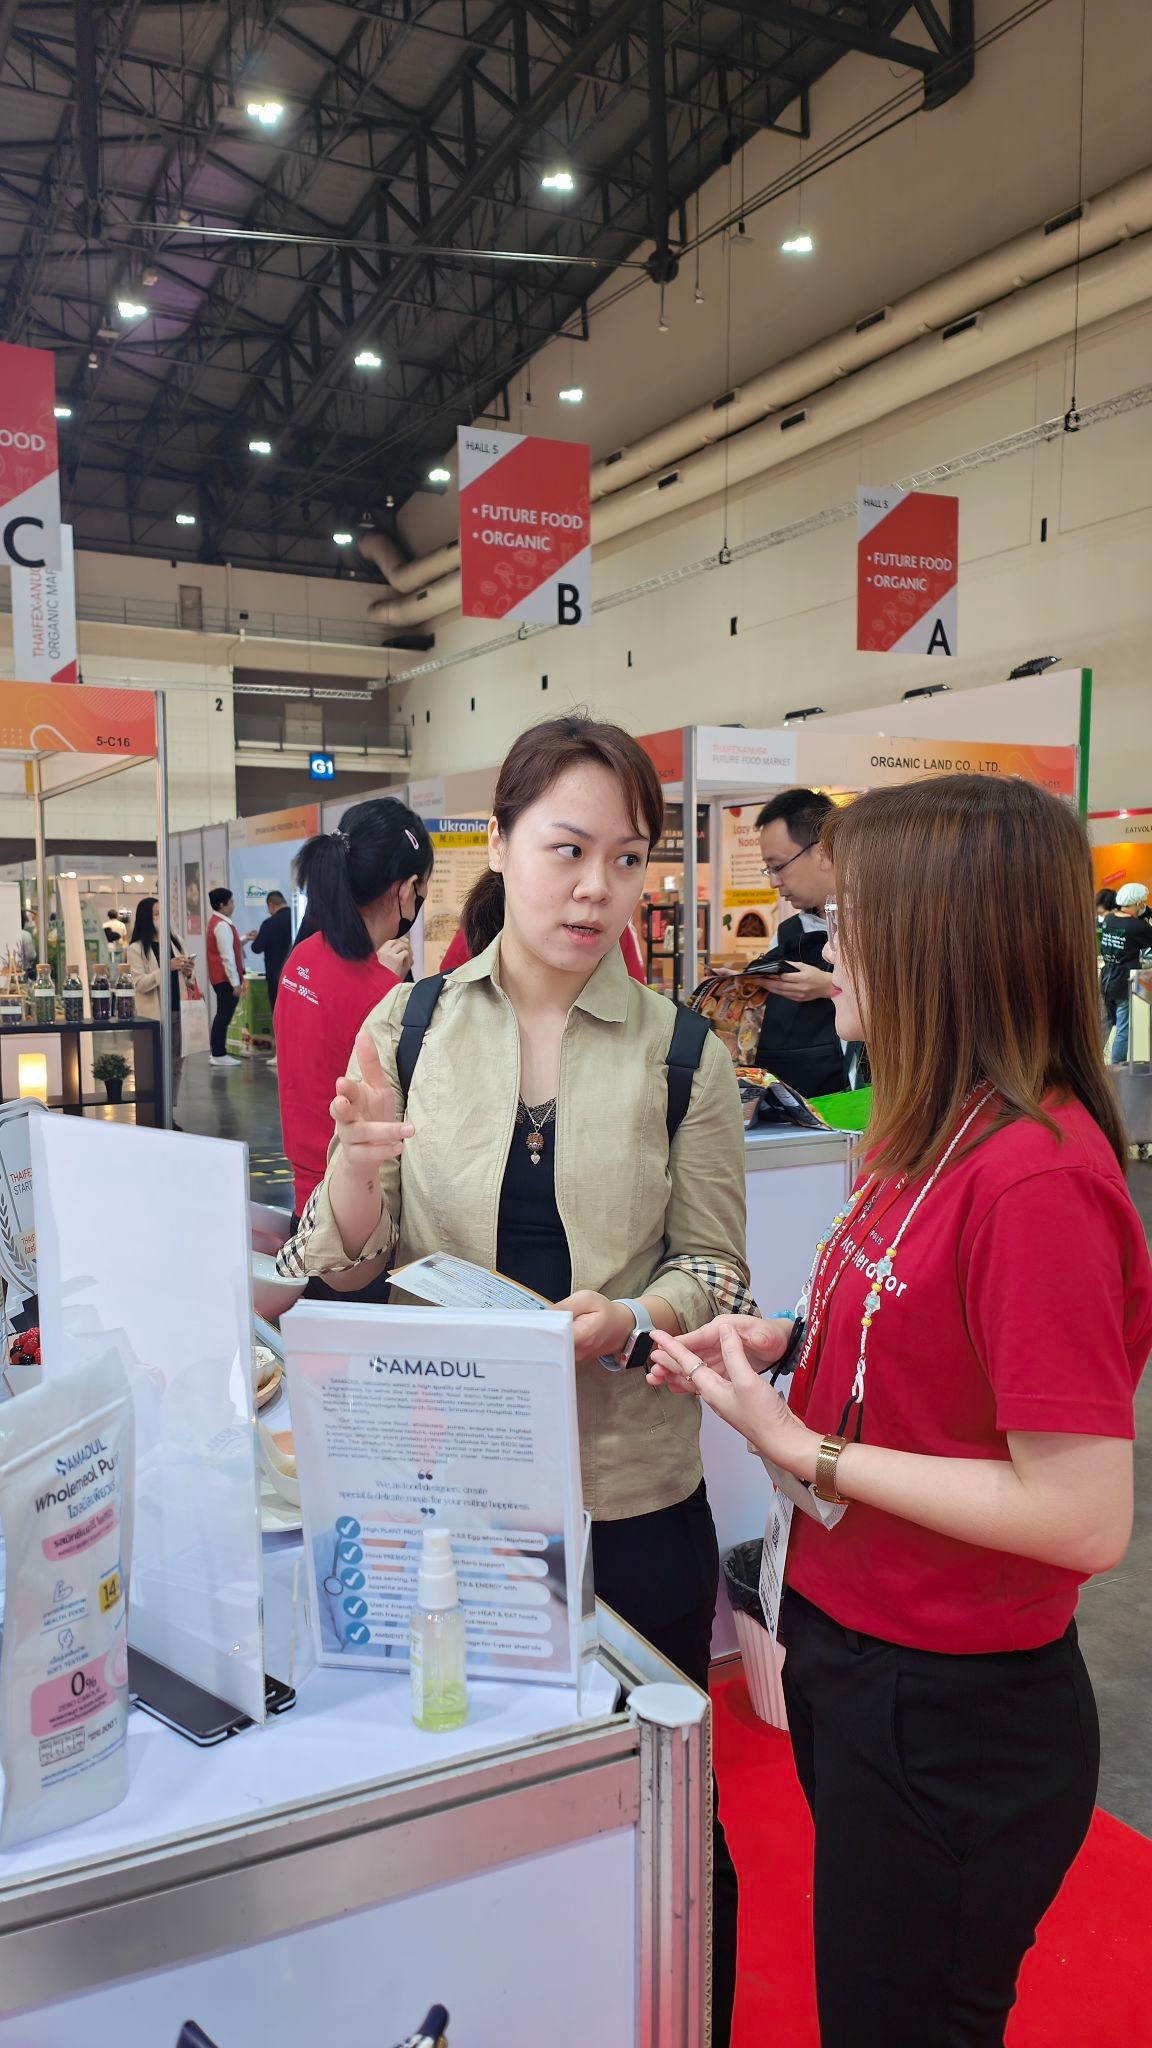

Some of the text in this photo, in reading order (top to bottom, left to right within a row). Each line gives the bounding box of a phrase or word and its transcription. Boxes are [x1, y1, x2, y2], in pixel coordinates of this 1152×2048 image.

[465, 440, 499, 454] HALL 5
[863, 498, 889, 509] HALL 5
[481, 504, 583, 530] FUTURE FOOD
[3, 516, 46, 568] C
[481, 530, 551, 551] ORGANIC
[873, 552, 952, 571] FUTURE FOOD
[873, 574, 928, 591] ORGANIC
[557, 583, 582, 626] B
[48, 600, 61, 660] ORGANIC
[926, 618, 951, 656] A
[215, 698, 223, 711] 2
[96, 736, 130, 747] 5-C16
[311, 759, 334, 775] G1
[741, 757, 762, 765] FOOD
[763, 757, 791, 767] MARKET
[870, 756, 1001, 773] ORGANIC LAND CO., LTD.
[799, 1316, 821, 1370] THAIFEX
[369, 1356, 485, 1378] SAMADUL
[56, 1438, 108, 1476] SAMADUL
[35, 1467, 96, 1513] Wholemeal
[103, 1579, 117, 1602] 14
[71, 1671, 97, 1697] 0%
